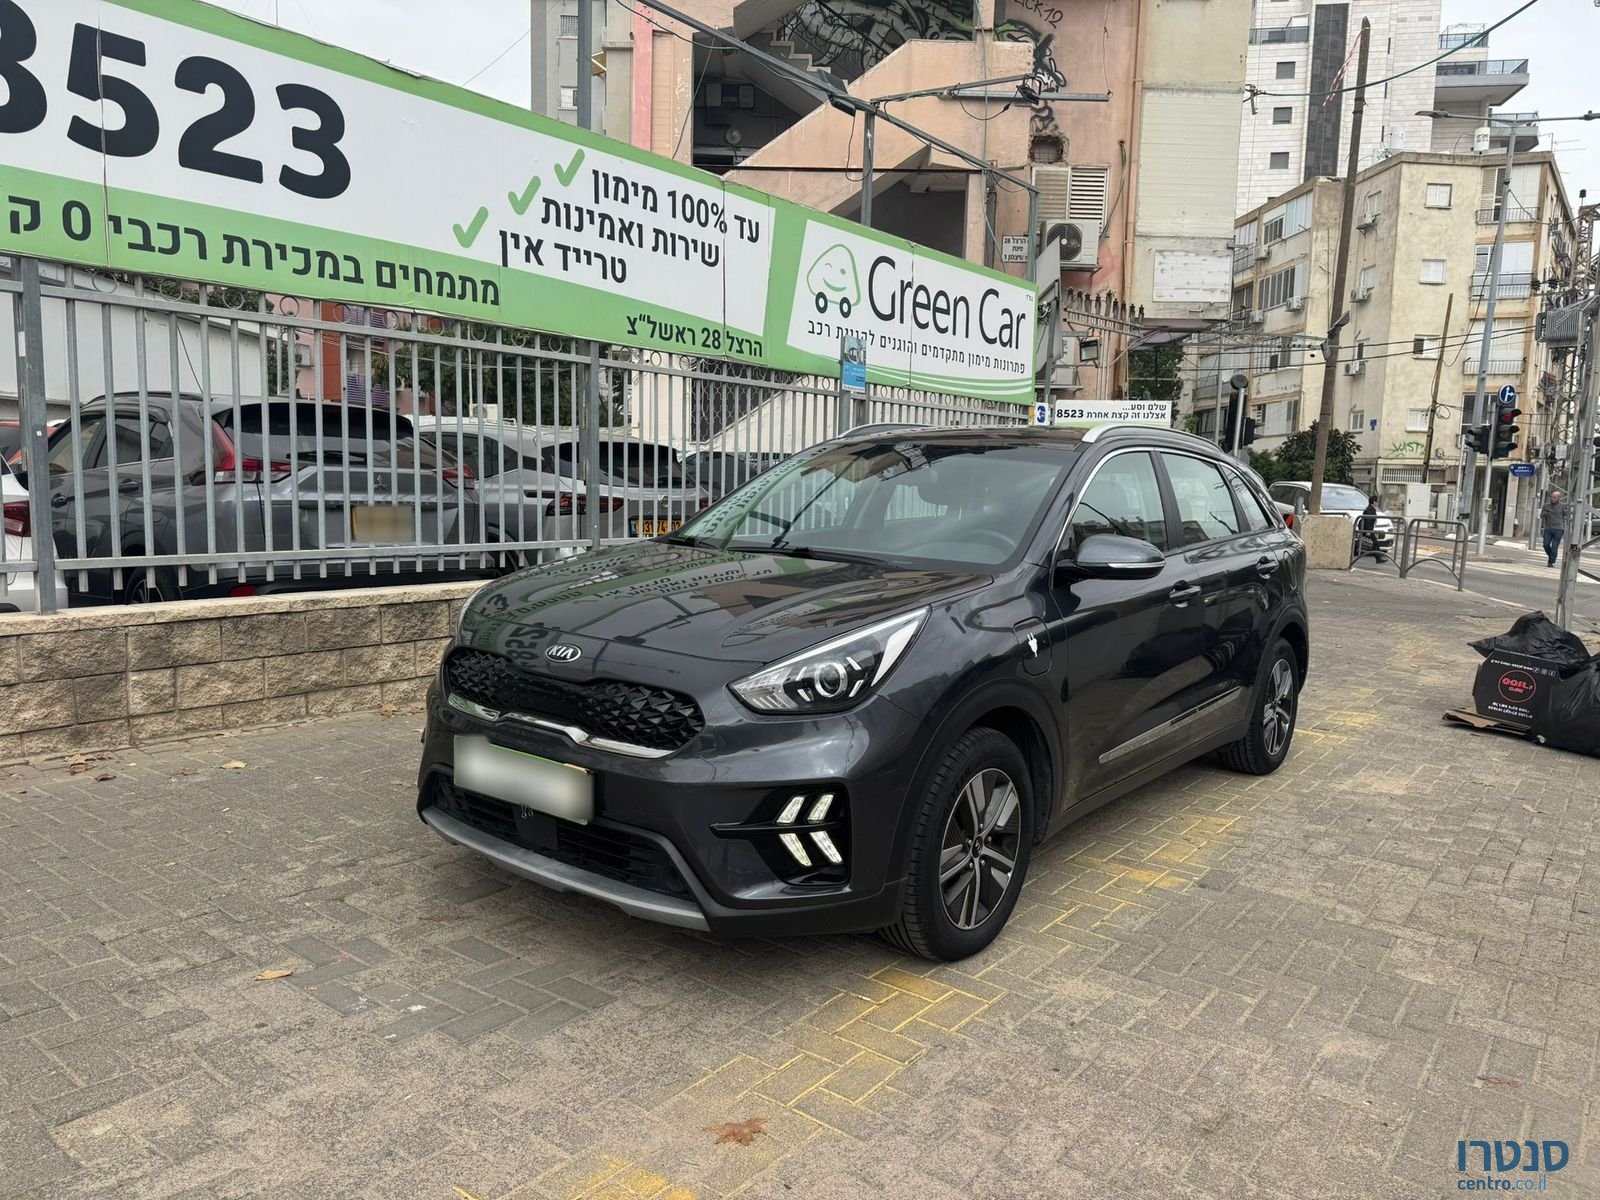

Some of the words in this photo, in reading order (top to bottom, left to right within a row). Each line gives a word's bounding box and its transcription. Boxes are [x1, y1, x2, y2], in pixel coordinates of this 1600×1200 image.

[592, 168, 658, 213] מימון
[62, 200, 92, 241] 0
[541, 196, 644, 249] ואמינות
[667, 190, 728, 234] 100%
[107, 213, 208, 260] רכבי
[734, 214, 760, 243] עד
[222, 233, 364, 285] במכירת
[499, 229, 545, 268] אין
[652, 227, 720, 268] שירות
[554, 242, 627, 284] טרייד
[376, 260, 500, 306] מתמחים
[868, 255, 970, 339] Green
[979, 288, 1026, 350] Car
[701, 327, 721, 350] 28
[808, 320, 831, 338] רכב
[726, 330, 763, 358] הרצל
[880, 335, 917, 354] והוגנים
[921, 343, 965, 364] מתקדמים
[968, 352, 991, 367] מימון
[993, 358, 1025, 374] פתרונות
[1056, 409, 1084, 418] 8523
[1086, 411, 1110, 419] אחרת
[1112, 412, 1129, 421] קצת
[1142, 411, 1167, 419] אצלנו
[1147, 403, 1167, 411] שלם
[547, 645, 575, 660] KIA
